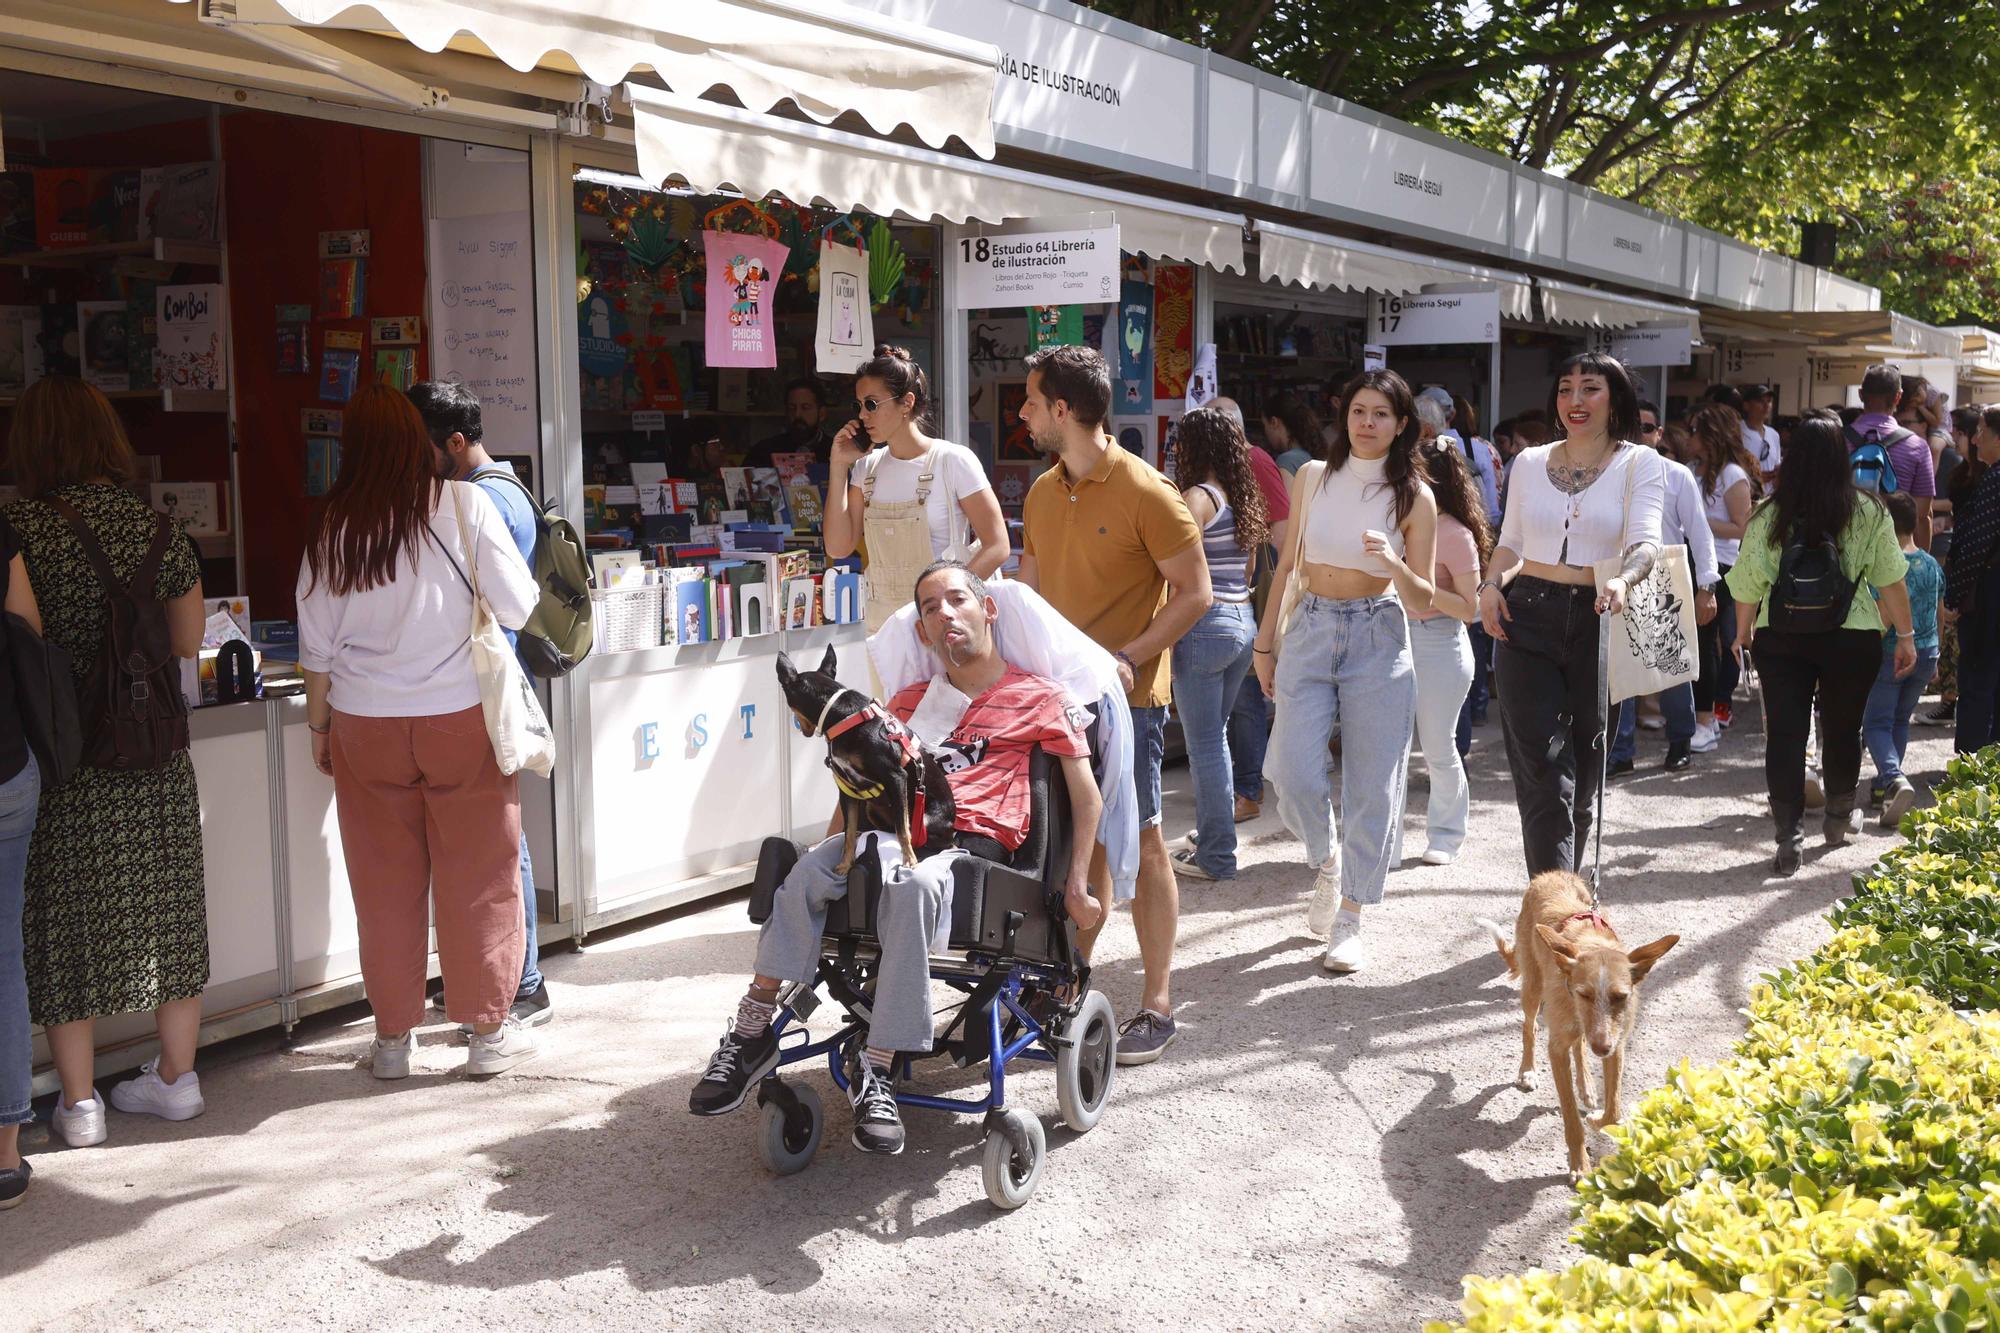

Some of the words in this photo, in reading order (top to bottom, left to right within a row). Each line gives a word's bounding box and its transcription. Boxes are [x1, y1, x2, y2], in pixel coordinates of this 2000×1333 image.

[1021, 62, 1039, 84] DE
[1041, 68, 1121, 107] ILUSTRACIÓN
[1393, 171, 1423, 192] LIBRERÍA
[1423, 179, 1443, 197] SEGUÍ
[960, 237, 990, 264] 18
[992, 242, 1033, 256] Estudio
[1035, 241, 1050, 253] 64
[1051, 238, 1095, 252] Librería
[992, 257, 1006, 269] de
[1008, 253, 1066, 268] ilustración
[1015, 273, 1024, 281] del
[1025, 272, 1042, 281] Zorro
[1043, 271, 1057, 281] Rojo
[1016, 283, 1034, 292] Books
[1378, 297, 1401, 314] 16
[1402, 299, 1436, 310] Librería
[1437, 298, 1462, 310] Seguí
[1377, 315, 1401, 333] 17
[578, 336, 616, 353] STUDIO
[1595, 329, 1613, 344] 16
[1728, 349, 1742, 360] 14
[1727, 361, 1743, 372] 15
